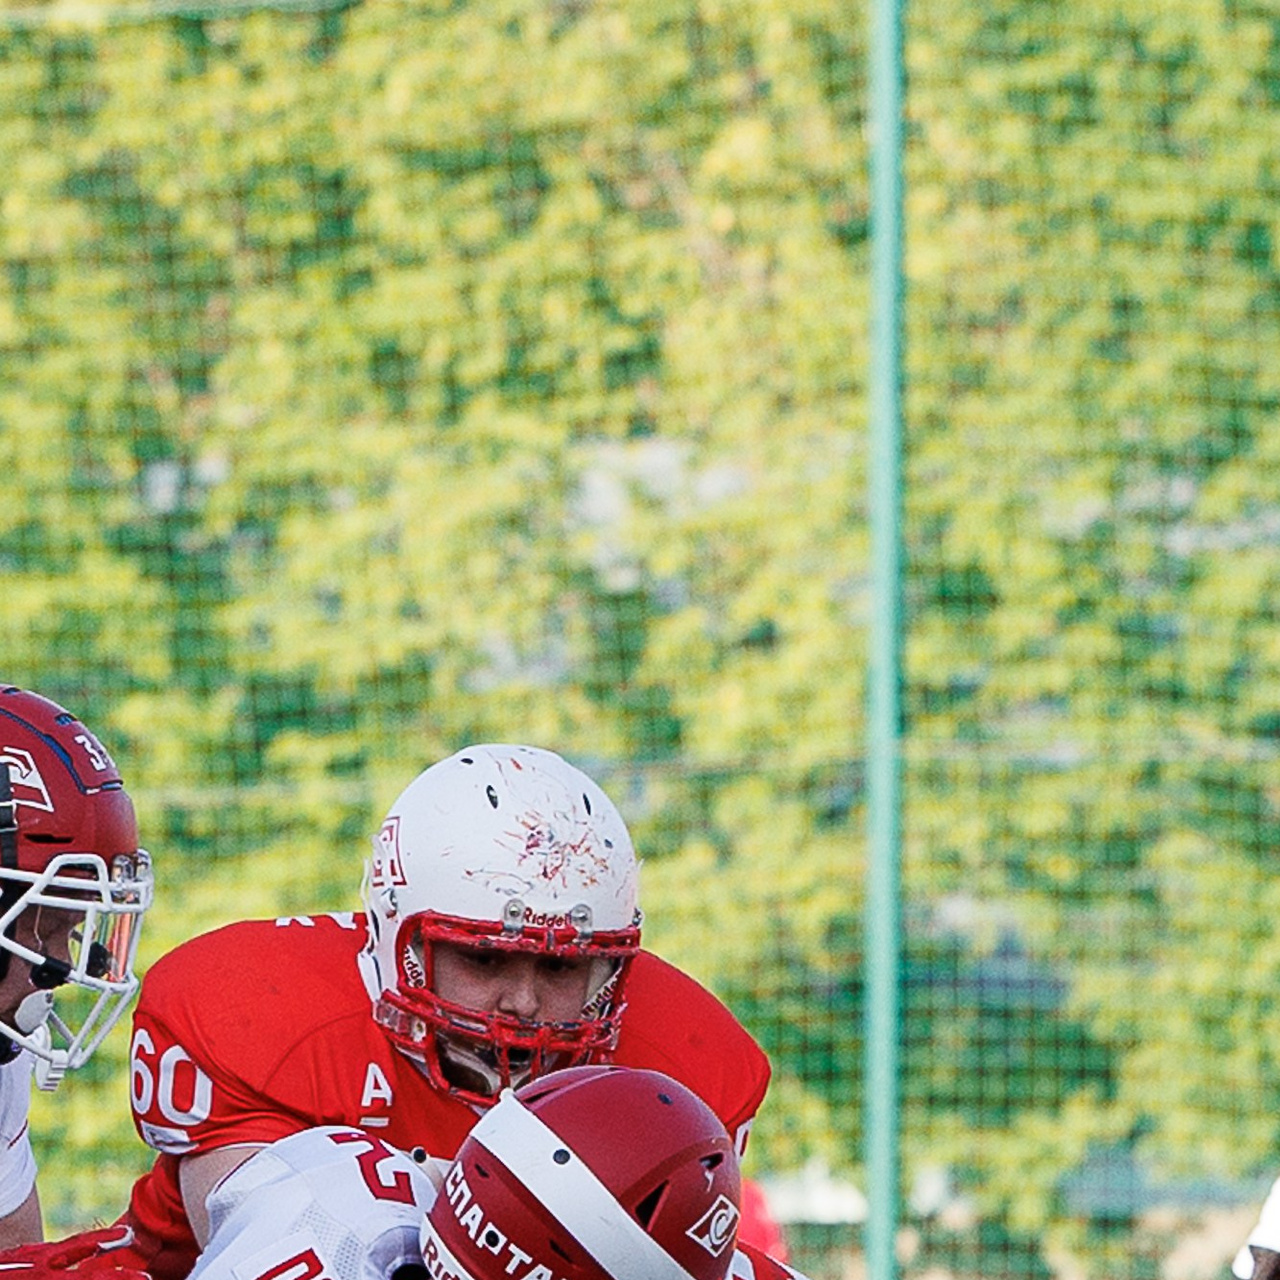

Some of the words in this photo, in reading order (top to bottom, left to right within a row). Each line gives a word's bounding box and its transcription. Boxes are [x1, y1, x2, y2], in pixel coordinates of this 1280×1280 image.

[130, 1028, 213, 1126] 60
[361, 1061, 394, 1109] A
[328, 1132, 418, 1208] 2
